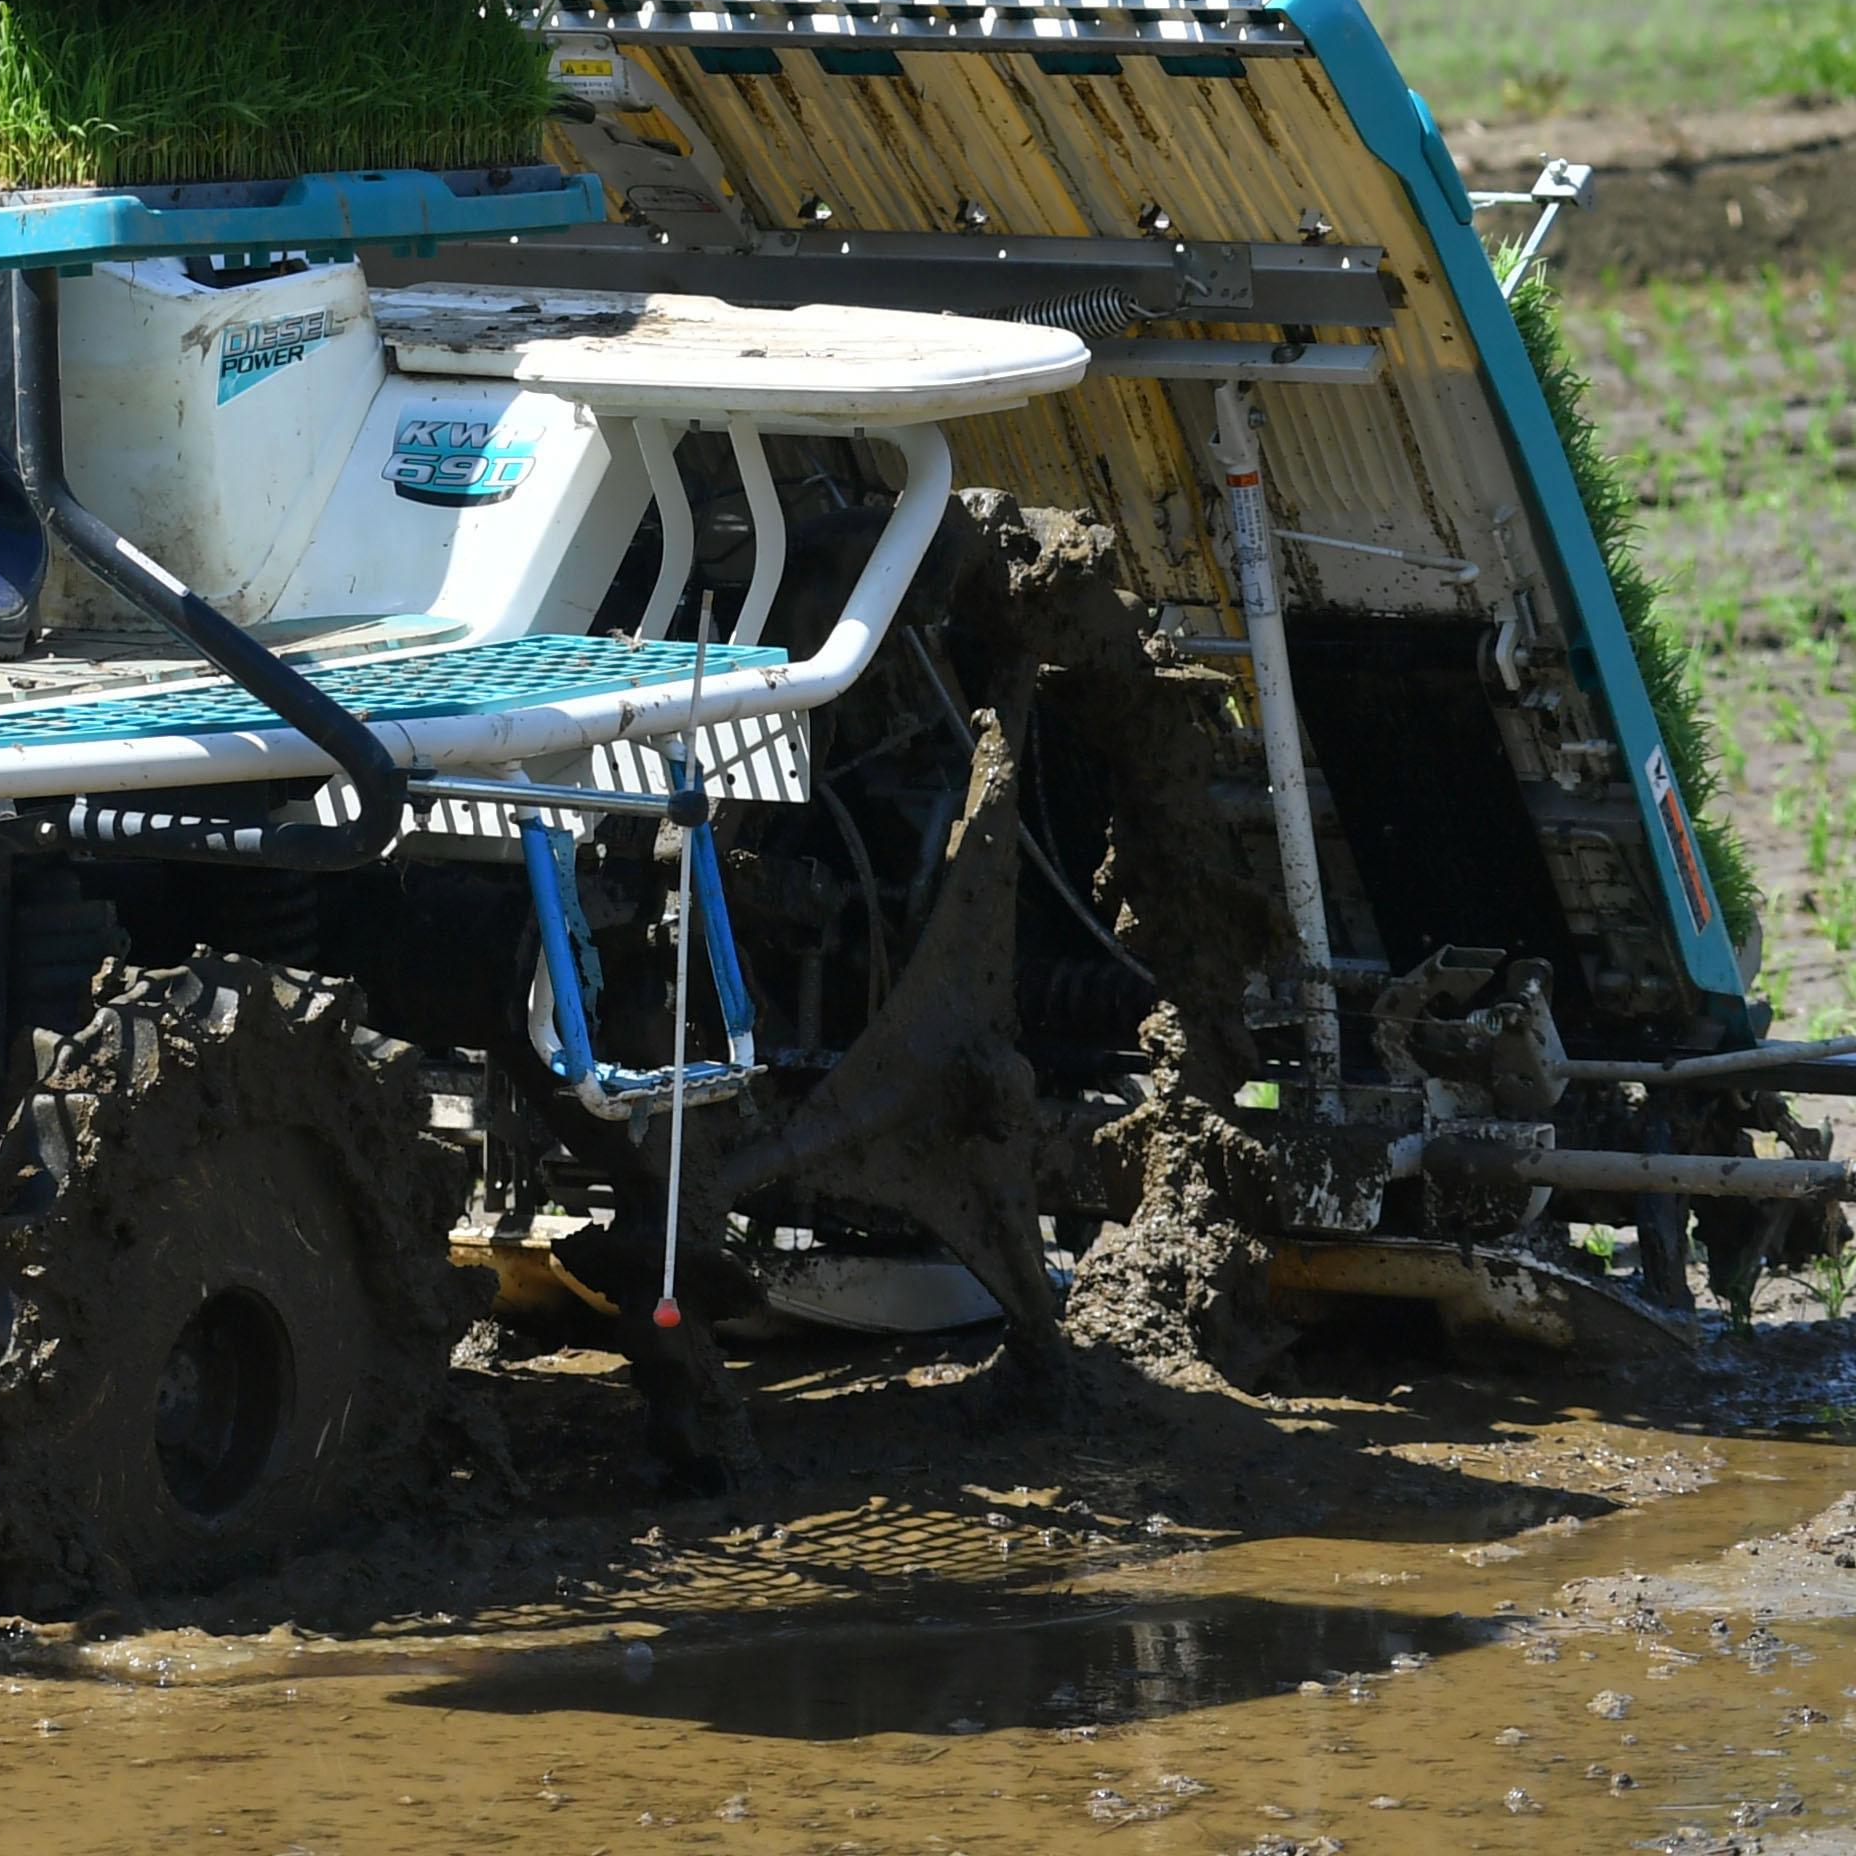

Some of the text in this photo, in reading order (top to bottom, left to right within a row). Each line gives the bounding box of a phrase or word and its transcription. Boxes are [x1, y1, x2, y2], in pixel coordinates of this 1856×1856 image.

[223, 310, 345, 357] DIESEL
[221, 345, 304, 378] POWER
[398, 420, 545, 449] KWP
[381, 452, 537, 487] 69D
